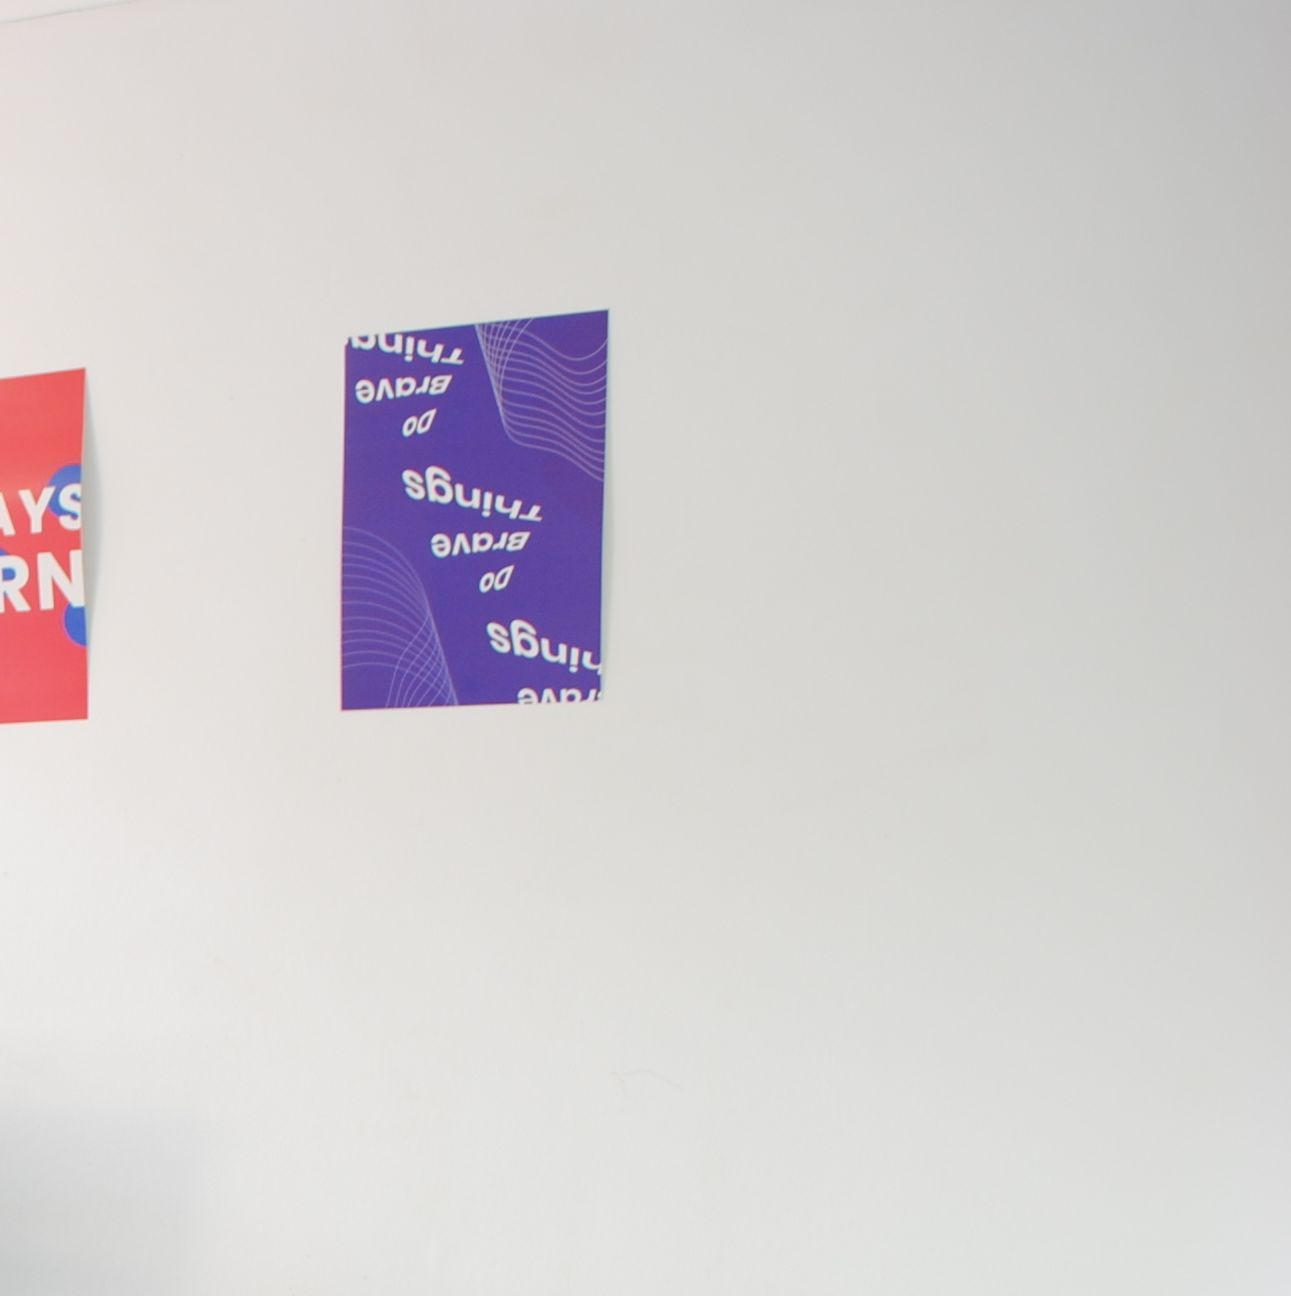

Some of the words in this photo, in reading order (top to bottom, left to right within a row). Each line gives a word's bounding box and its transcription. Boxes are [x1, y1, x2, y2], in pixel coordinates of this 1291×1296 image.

[355, 374, 453, 404] Brave
[402, 407, 437, 437] Do
[402, 465, 543, 522] Things
[431, 531, 531, 558] Brave
[479, 564, 515, 593] Do
[486, 619, 602, 675] hings
[517, 687, 602, 704] rave
